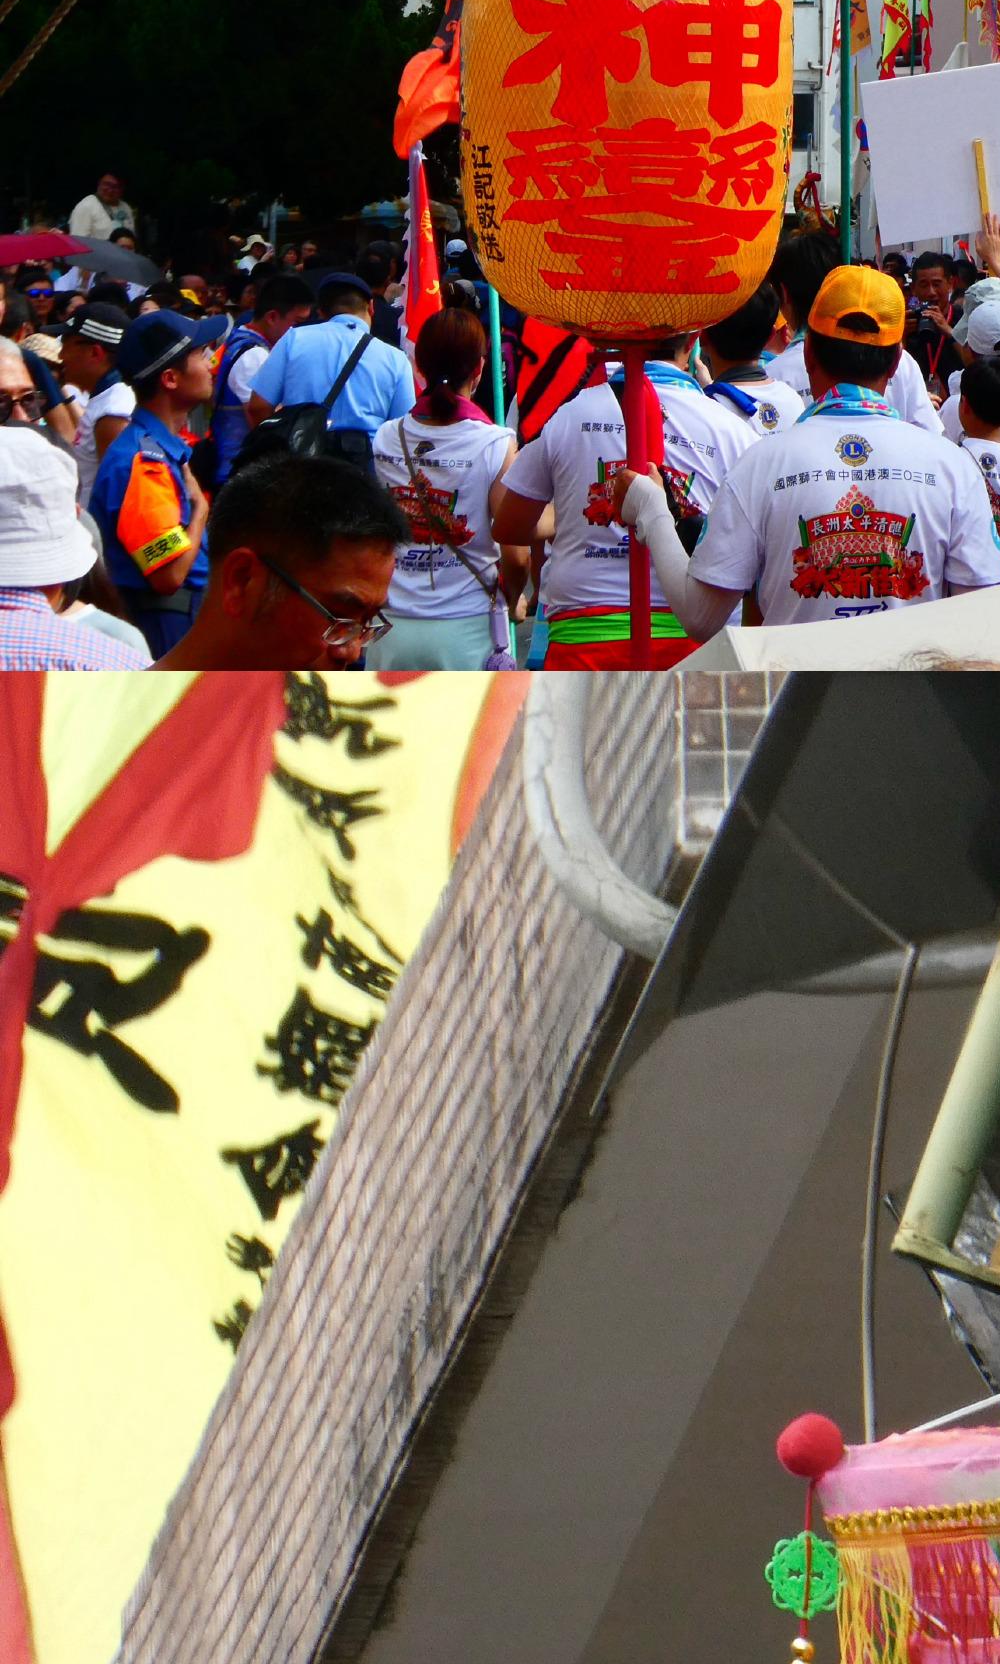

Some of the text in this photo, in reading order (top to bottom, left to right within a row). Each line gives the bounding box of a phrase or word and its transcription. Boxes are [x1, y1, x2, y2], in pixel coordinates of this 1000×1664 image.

[811, 516, 904, 536] 長洲太平清醮
